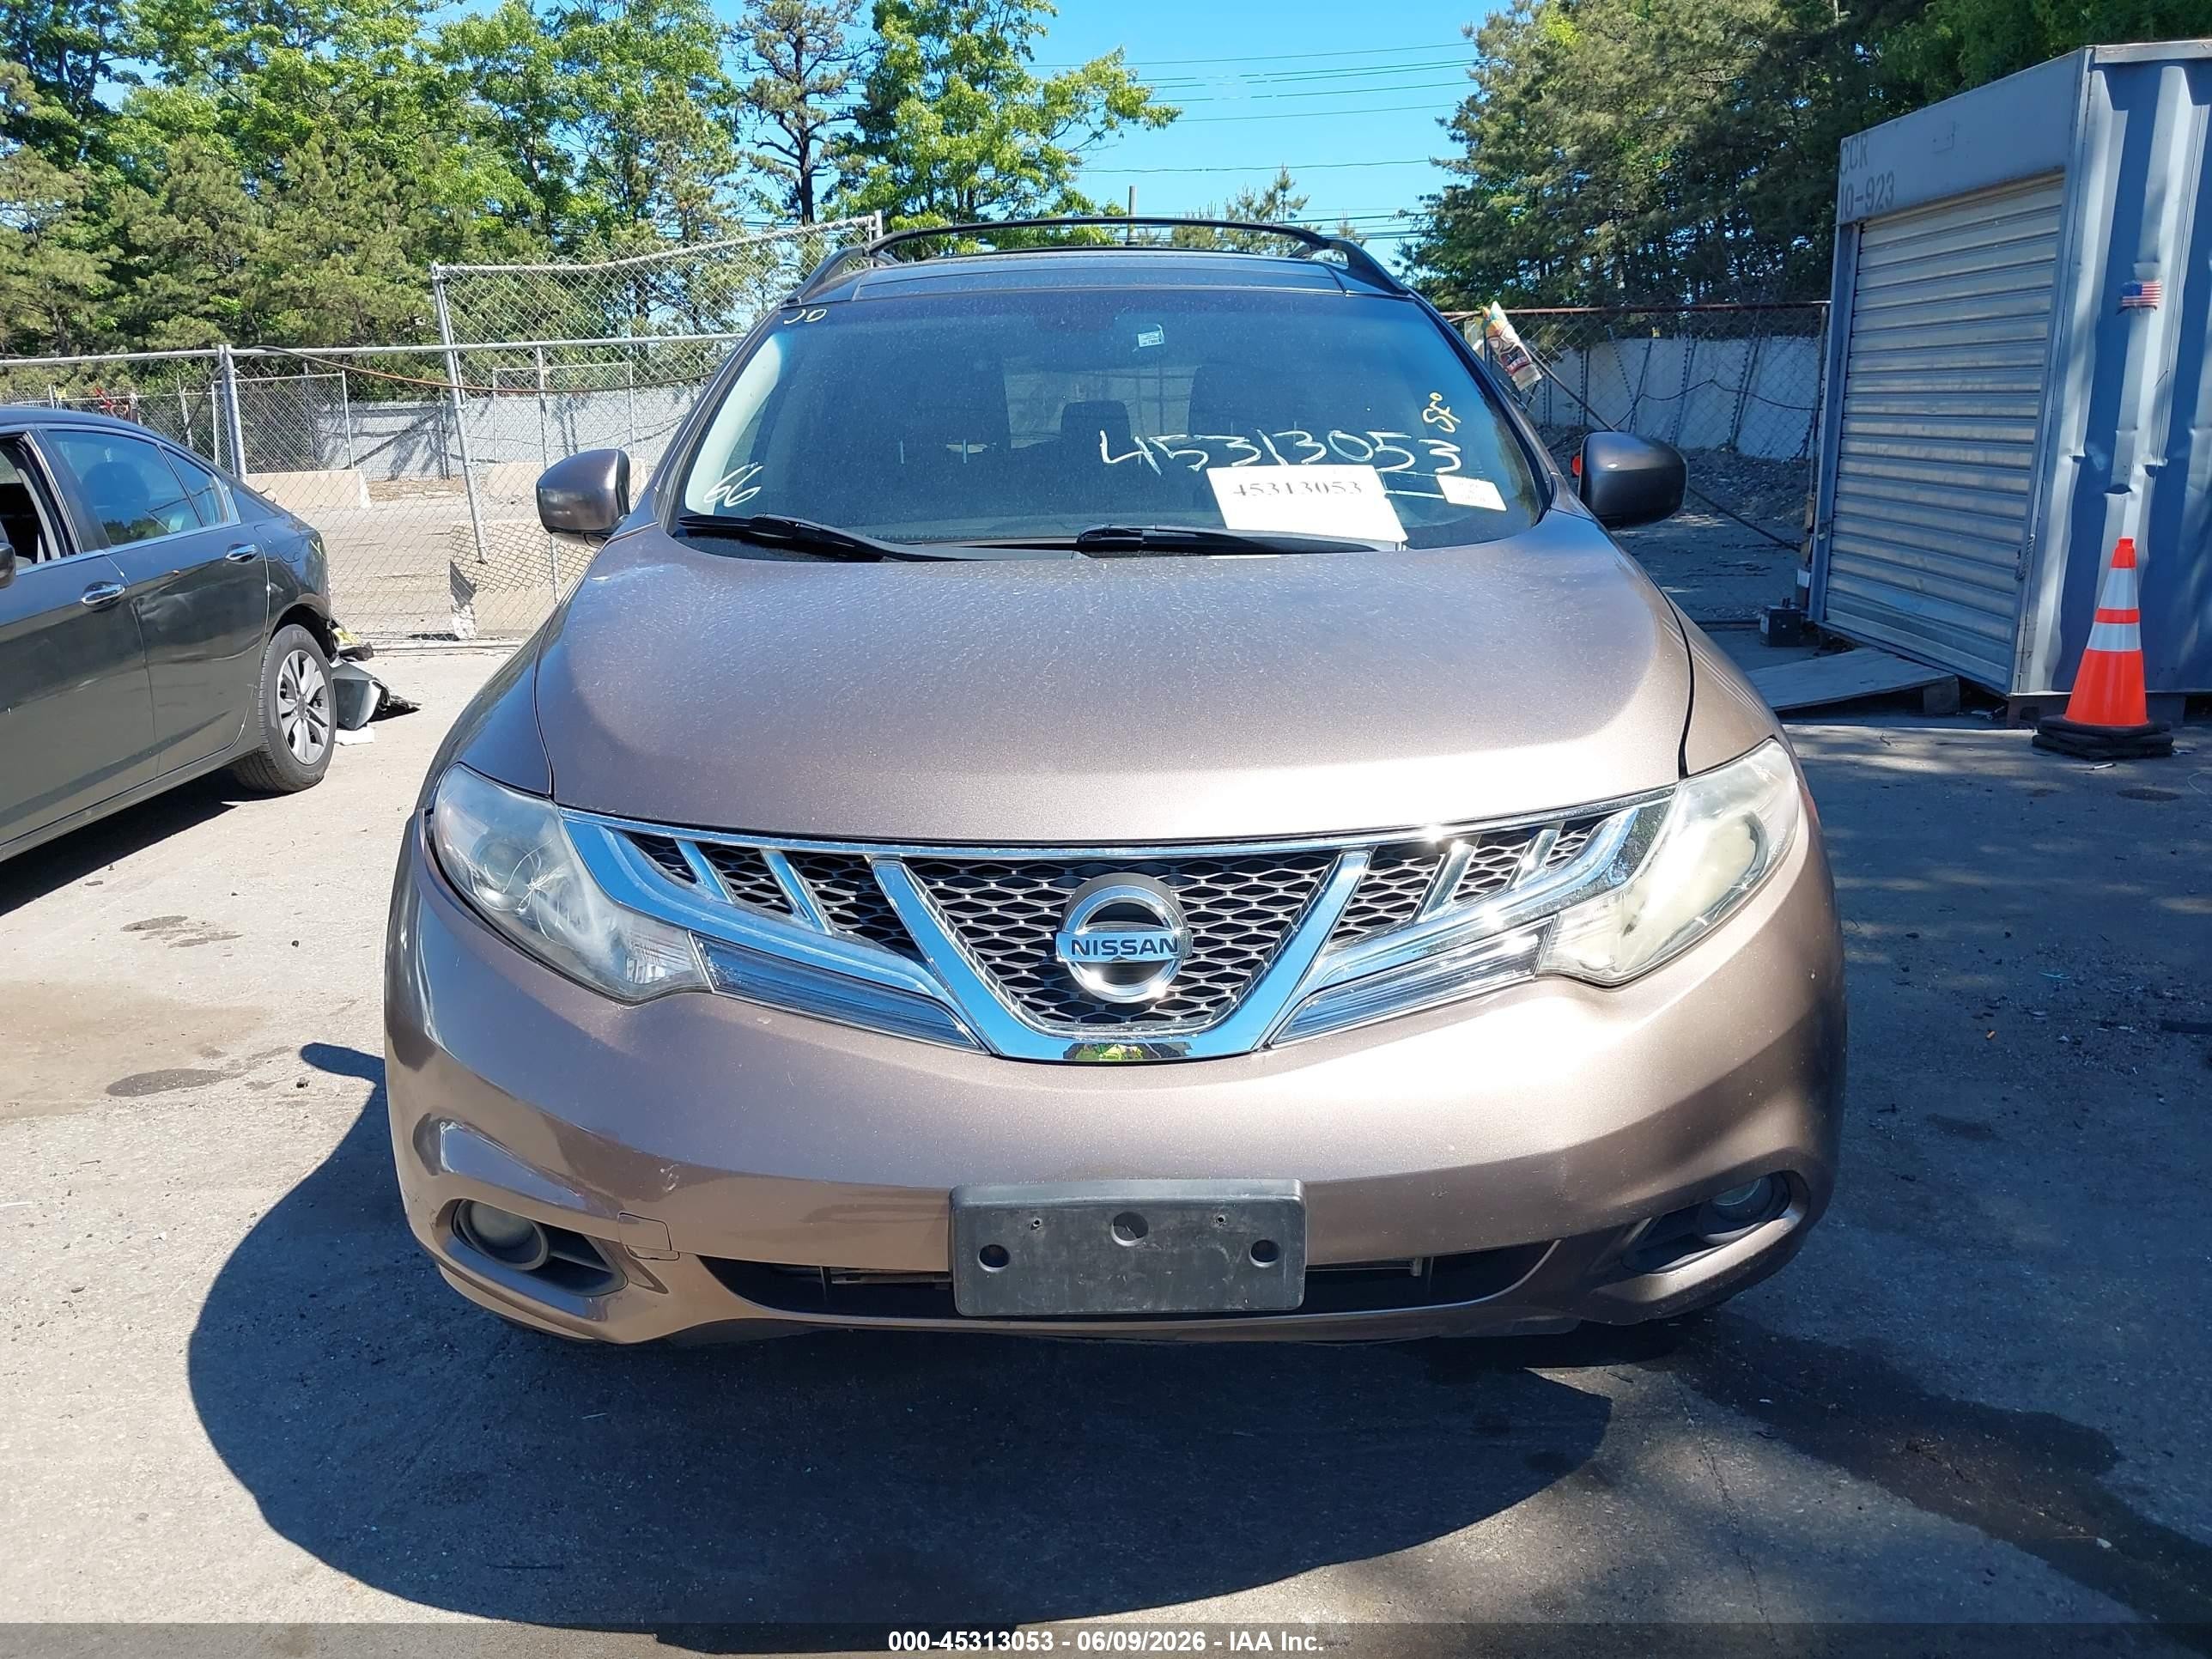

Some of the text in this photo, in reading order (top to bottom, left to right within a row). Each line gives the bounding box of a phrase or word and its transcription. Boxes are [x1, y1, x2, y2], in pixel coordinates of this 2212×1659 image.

[1840, 170, 1895, 217] 10-923
[1099, 428, 1462, 477] 45313053
[1231, 480, 1363, 497] 45313053
[1071, 938, 1179, 956] NISSAN
